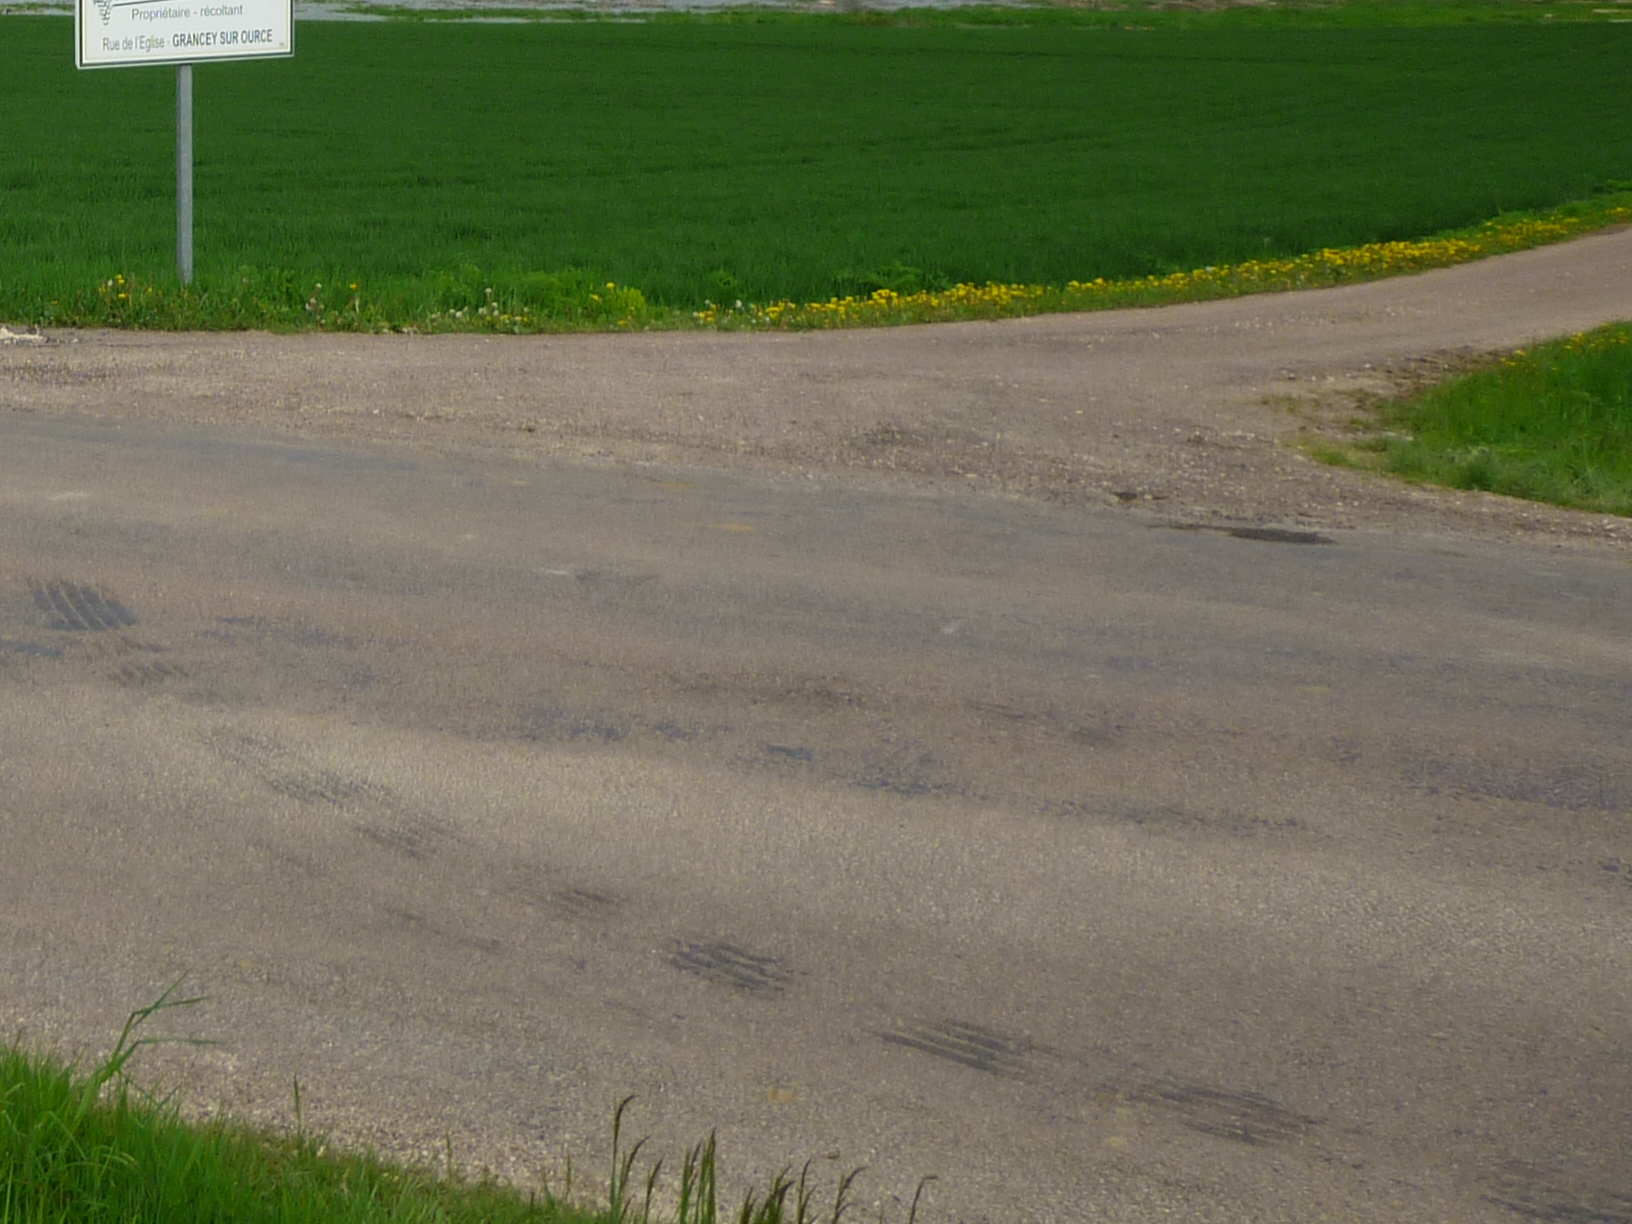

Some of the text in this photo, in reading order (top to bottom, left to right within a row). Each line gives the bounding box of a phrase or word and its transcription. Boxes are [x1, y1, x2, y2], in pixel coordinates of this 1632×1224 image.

[131, 7, 190, 21] Propriétaire
[200, 5, 243, 17] récoltant
[102, 37, 120, 51] Rue
[122, 37, 133, 50] de
[172, 30, 217, 47] GRANCEY
[220, 29, 238, 44] SUR
[240, 29, 273, 43] OURCE
